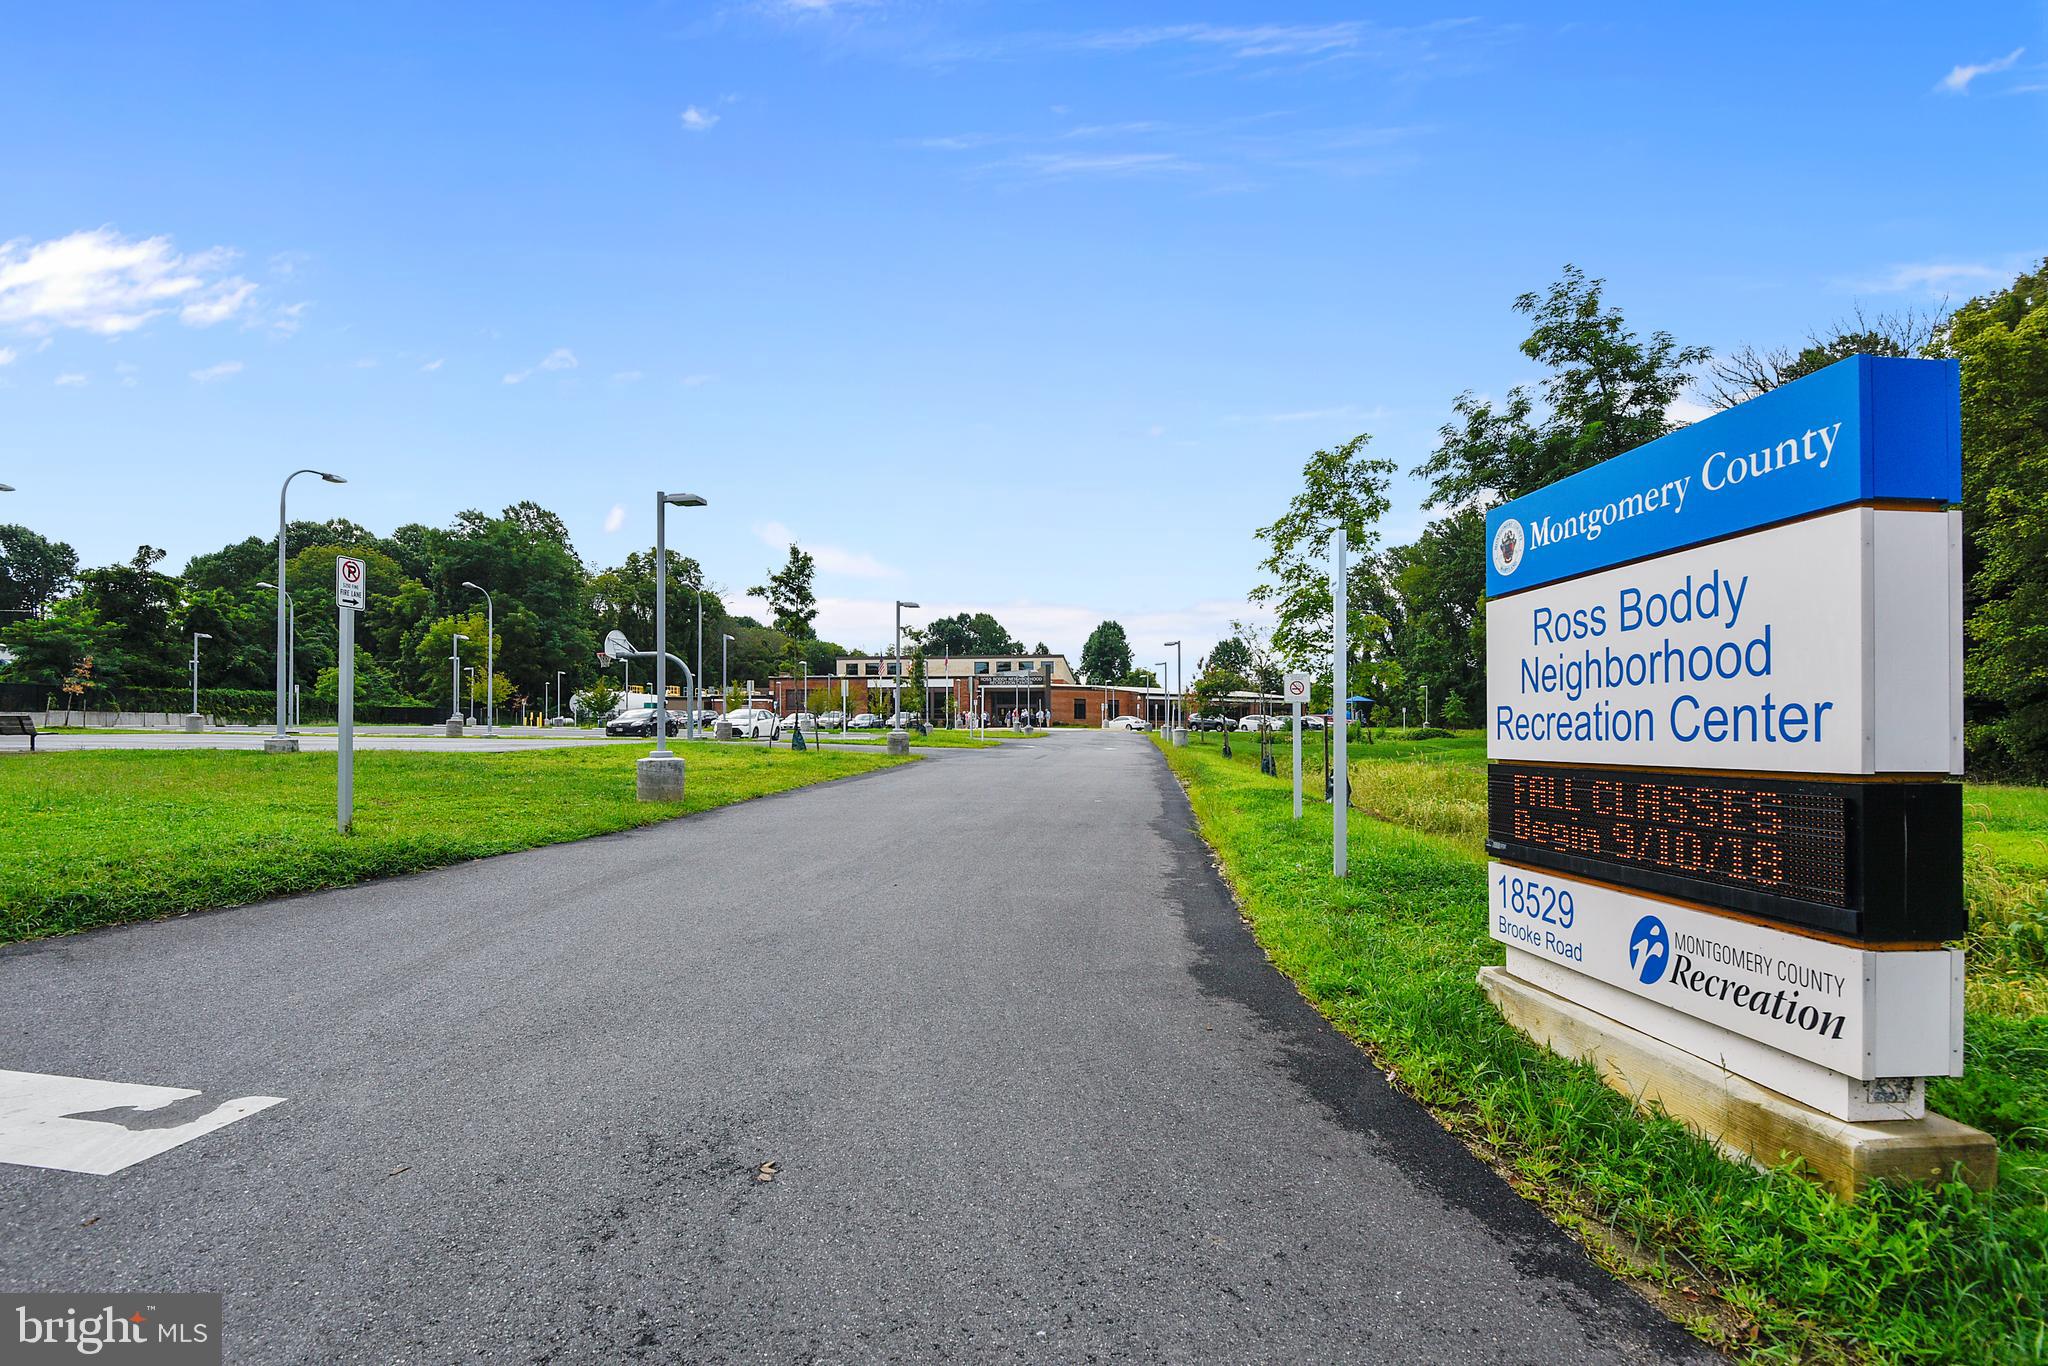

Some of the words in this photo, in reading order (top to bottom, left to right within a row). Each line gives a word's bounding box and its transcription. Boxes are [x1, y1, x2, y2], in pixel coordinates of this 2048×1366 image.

[1529, 475, 1692, 550] Montgomery
[1702, 422, 1842, 491] County
[1533, 604, 1607, 645] Ross
[1619, 568, 1749, 632] Boddy
[1521, 623, 1772, 704] Neighborhood
[1497, 704, 1655, 742] Recreation
[1670, 692, 1834, 744] Center
[1514, 774, 1581, 811] FALL
[1592, 780, 1784, 836] CLASSES
[1514, 809, 1601, 853] Begin
[1610, 822, 1785, 886] 9/10/18
[1498, 875, 1575, 929] 18529
[1498, 916, 1542, 947] Brooke
[1545, 931, 1583, 963] Road
[1675, 931, 1773, 977] MONTGOMERY
[1777, 960, 1846, 998] COUNTY
[1668, 954, 1847, 1041] Recreation
